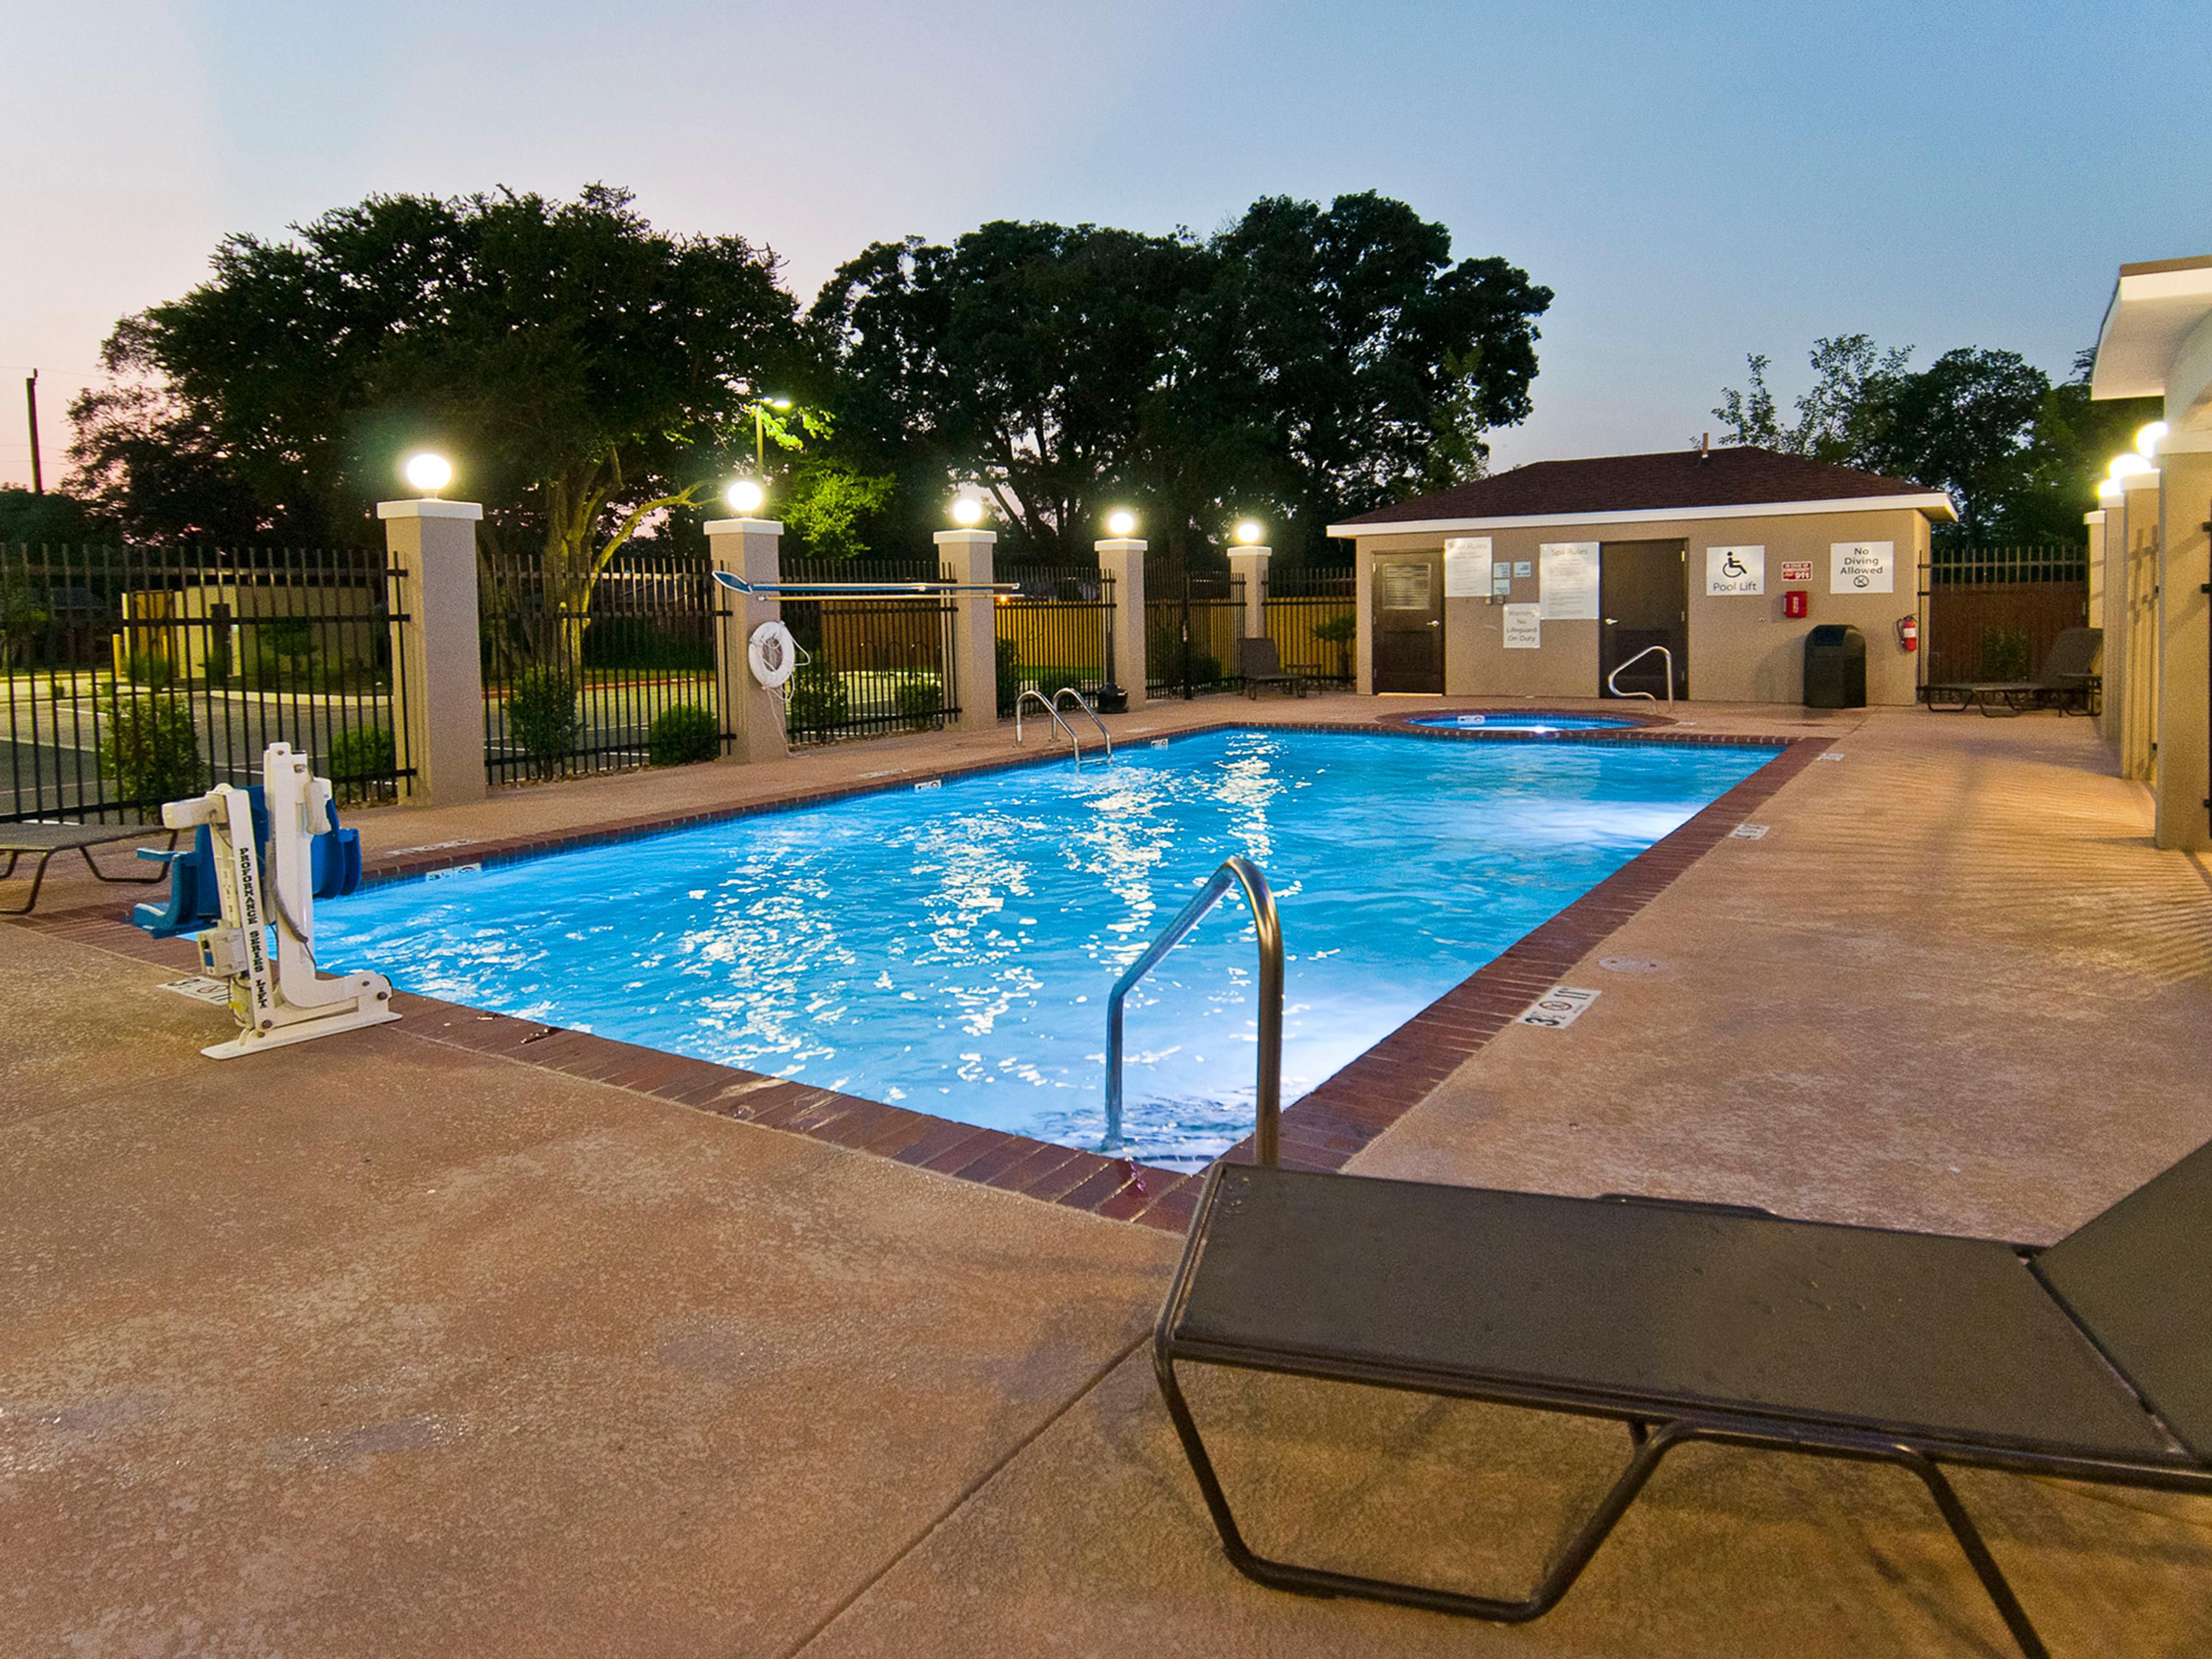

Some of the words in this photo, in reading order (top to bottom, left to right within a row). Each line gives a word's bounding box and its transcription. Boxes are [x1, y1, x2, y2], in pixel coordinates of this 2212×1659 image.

[1551, 548, 1566, 557] Spa
[1844, 557, 1879, 566] Diving
[1839, 566, 1884, 574] Allowed
[1712, 582, 1737, 591] Pool
[1740, 581, 1757, 591] Lift
[239, 847, 258, 925] PROFORMANCE
[249, 931, 263, 973] SERIES
